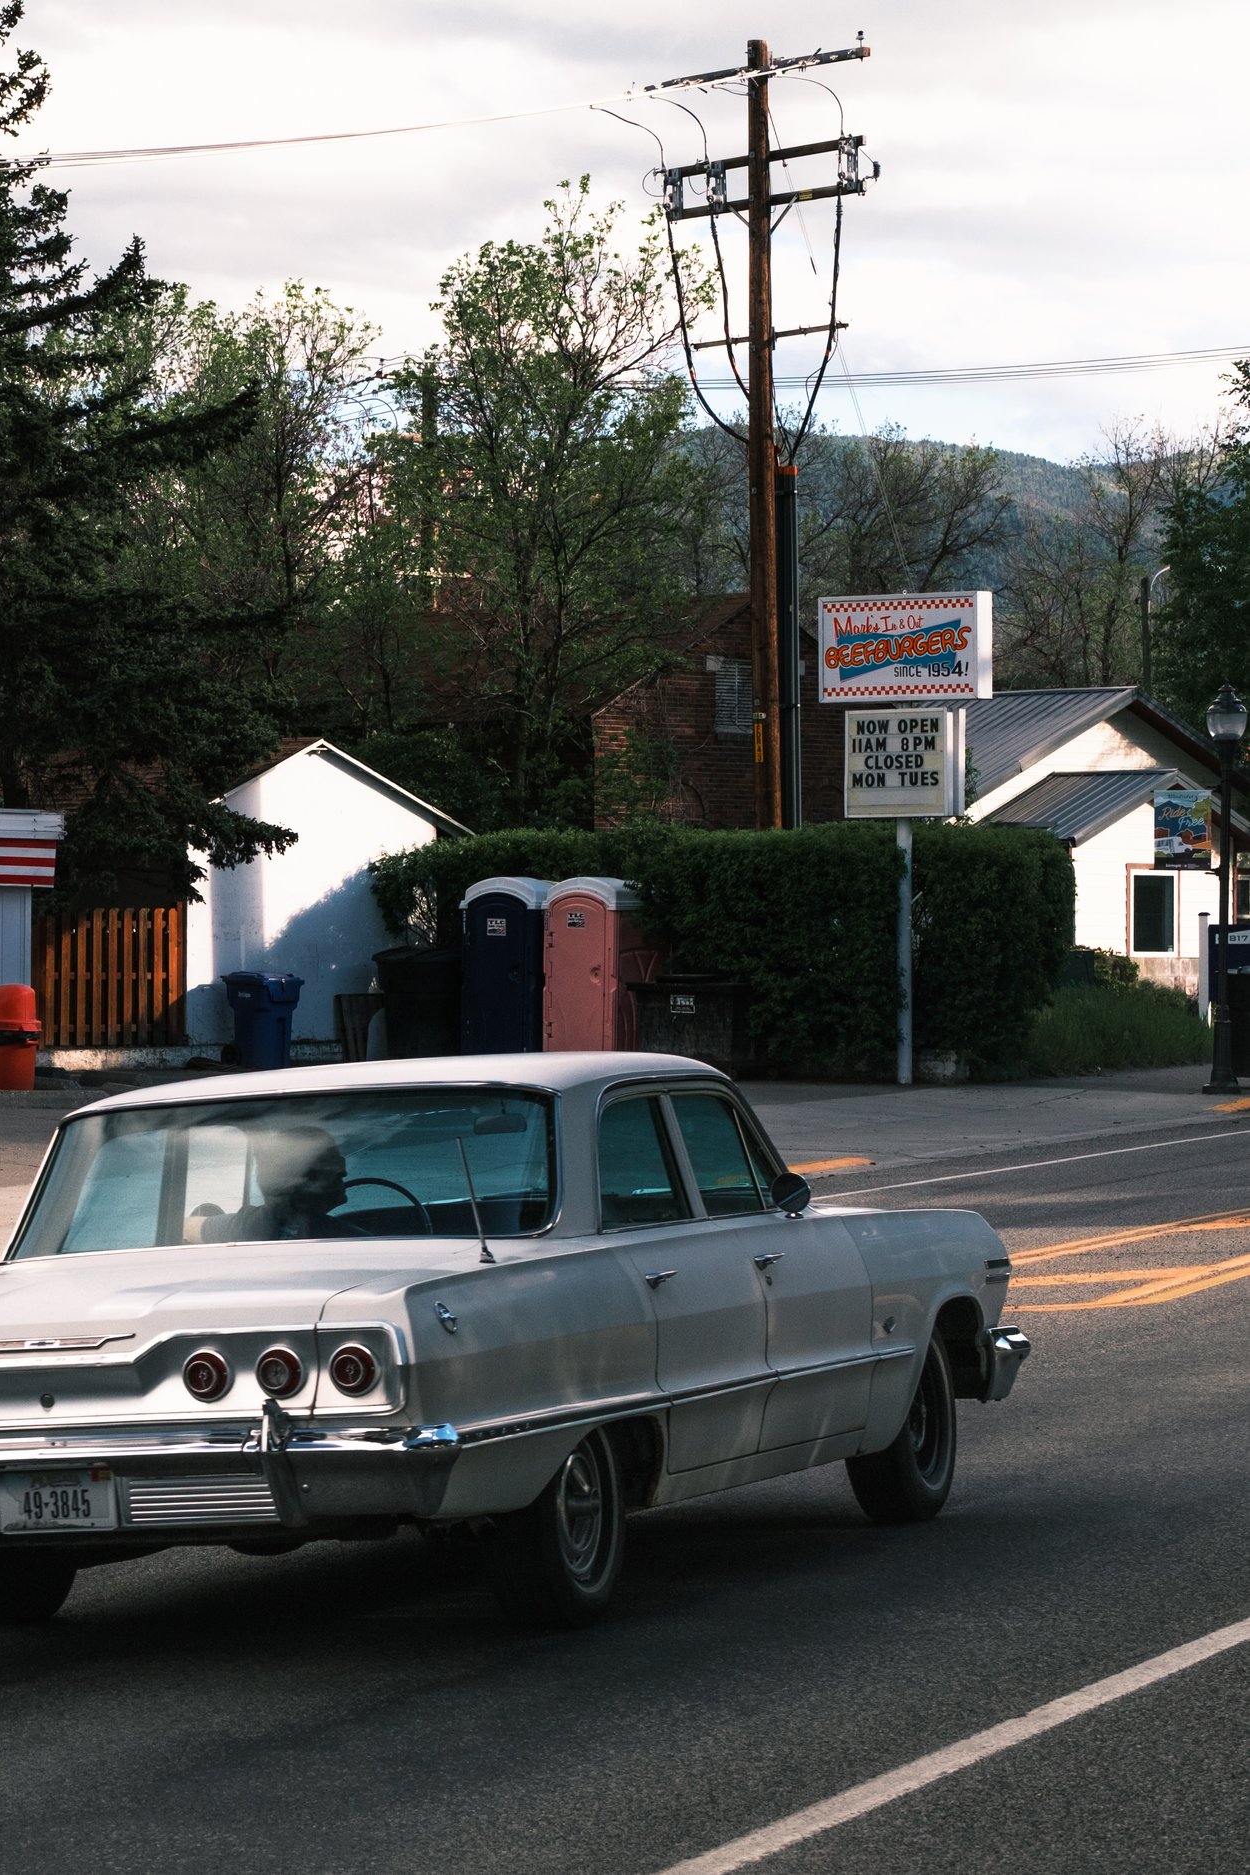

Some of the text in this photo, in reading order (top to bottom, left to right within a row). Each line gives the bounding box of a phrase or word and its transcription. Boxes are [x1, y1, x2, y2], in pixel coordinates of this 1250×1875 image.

[833, 614, 924, 638] Mark's In & Out
[824, 626, 972, 670] BEEFBURGERS
[893, 660, 969, 677] SINCE 1954!
[856, 718, 939, 735] NOW OPEN
[852, 737, 887, 753] 11AM
[864, 754, 924, 769] CLOSED
[852, 771, 939, 788] MON TUES
[1158, 804, 1186, 820] Ride
[1177, 817, 1206, 830] Free
[1229, 934, 1249, 942] B17
